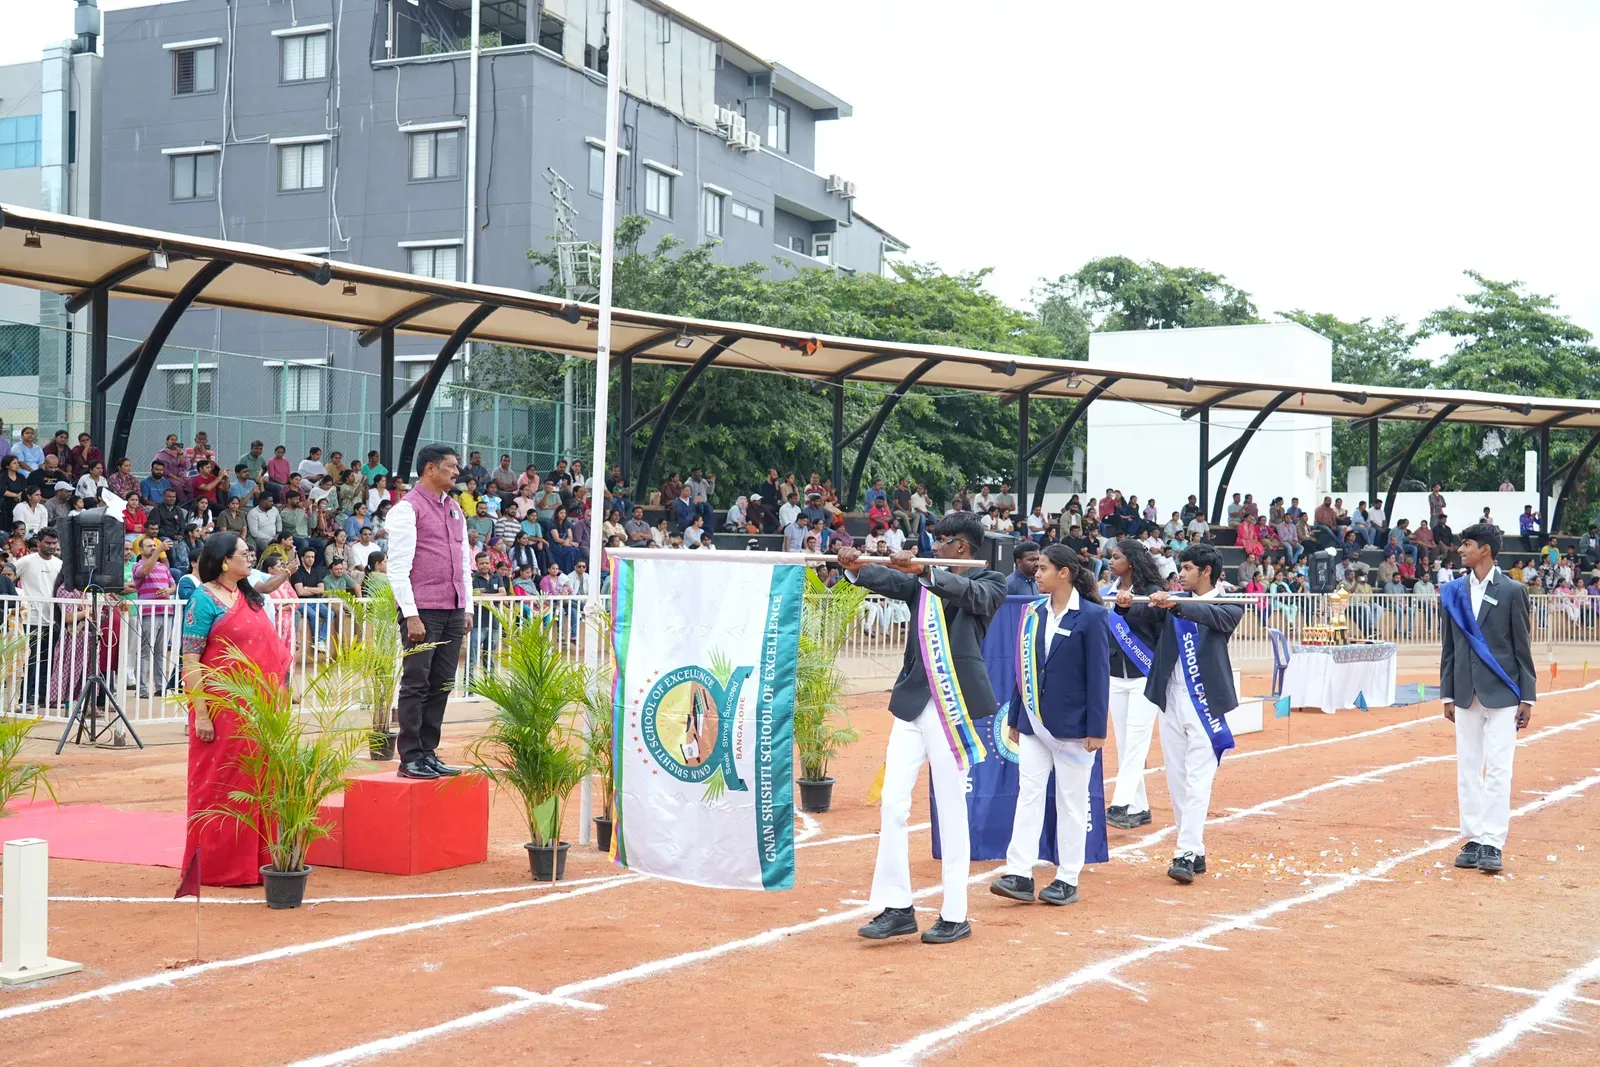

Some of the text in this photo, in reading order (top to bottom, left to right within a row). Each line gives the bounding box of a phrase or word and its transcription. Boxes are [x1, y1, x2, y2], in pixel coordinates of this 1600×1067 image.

[1023, 633, 1031, 681] SPORTS
[1115, 622, 1133, 648] SCHOOL
[1183, 632, 1202, 682] SCHOOL
[652, 684, 666, 701] OF
[723, 681, 739, 718] Succeed
[935, 663, 963, 726] CAPTAIN
[644, 701, 659, 748] SCHOOL
[736, 697, 745, 760] BANGALORE
[760, 595, 782, 862] GNAN SRISHTI SCHOOL OF EXCELLENCE
[655, 748, 689, 778] SRISHTI
[724, 752, 732, 775] Seek
